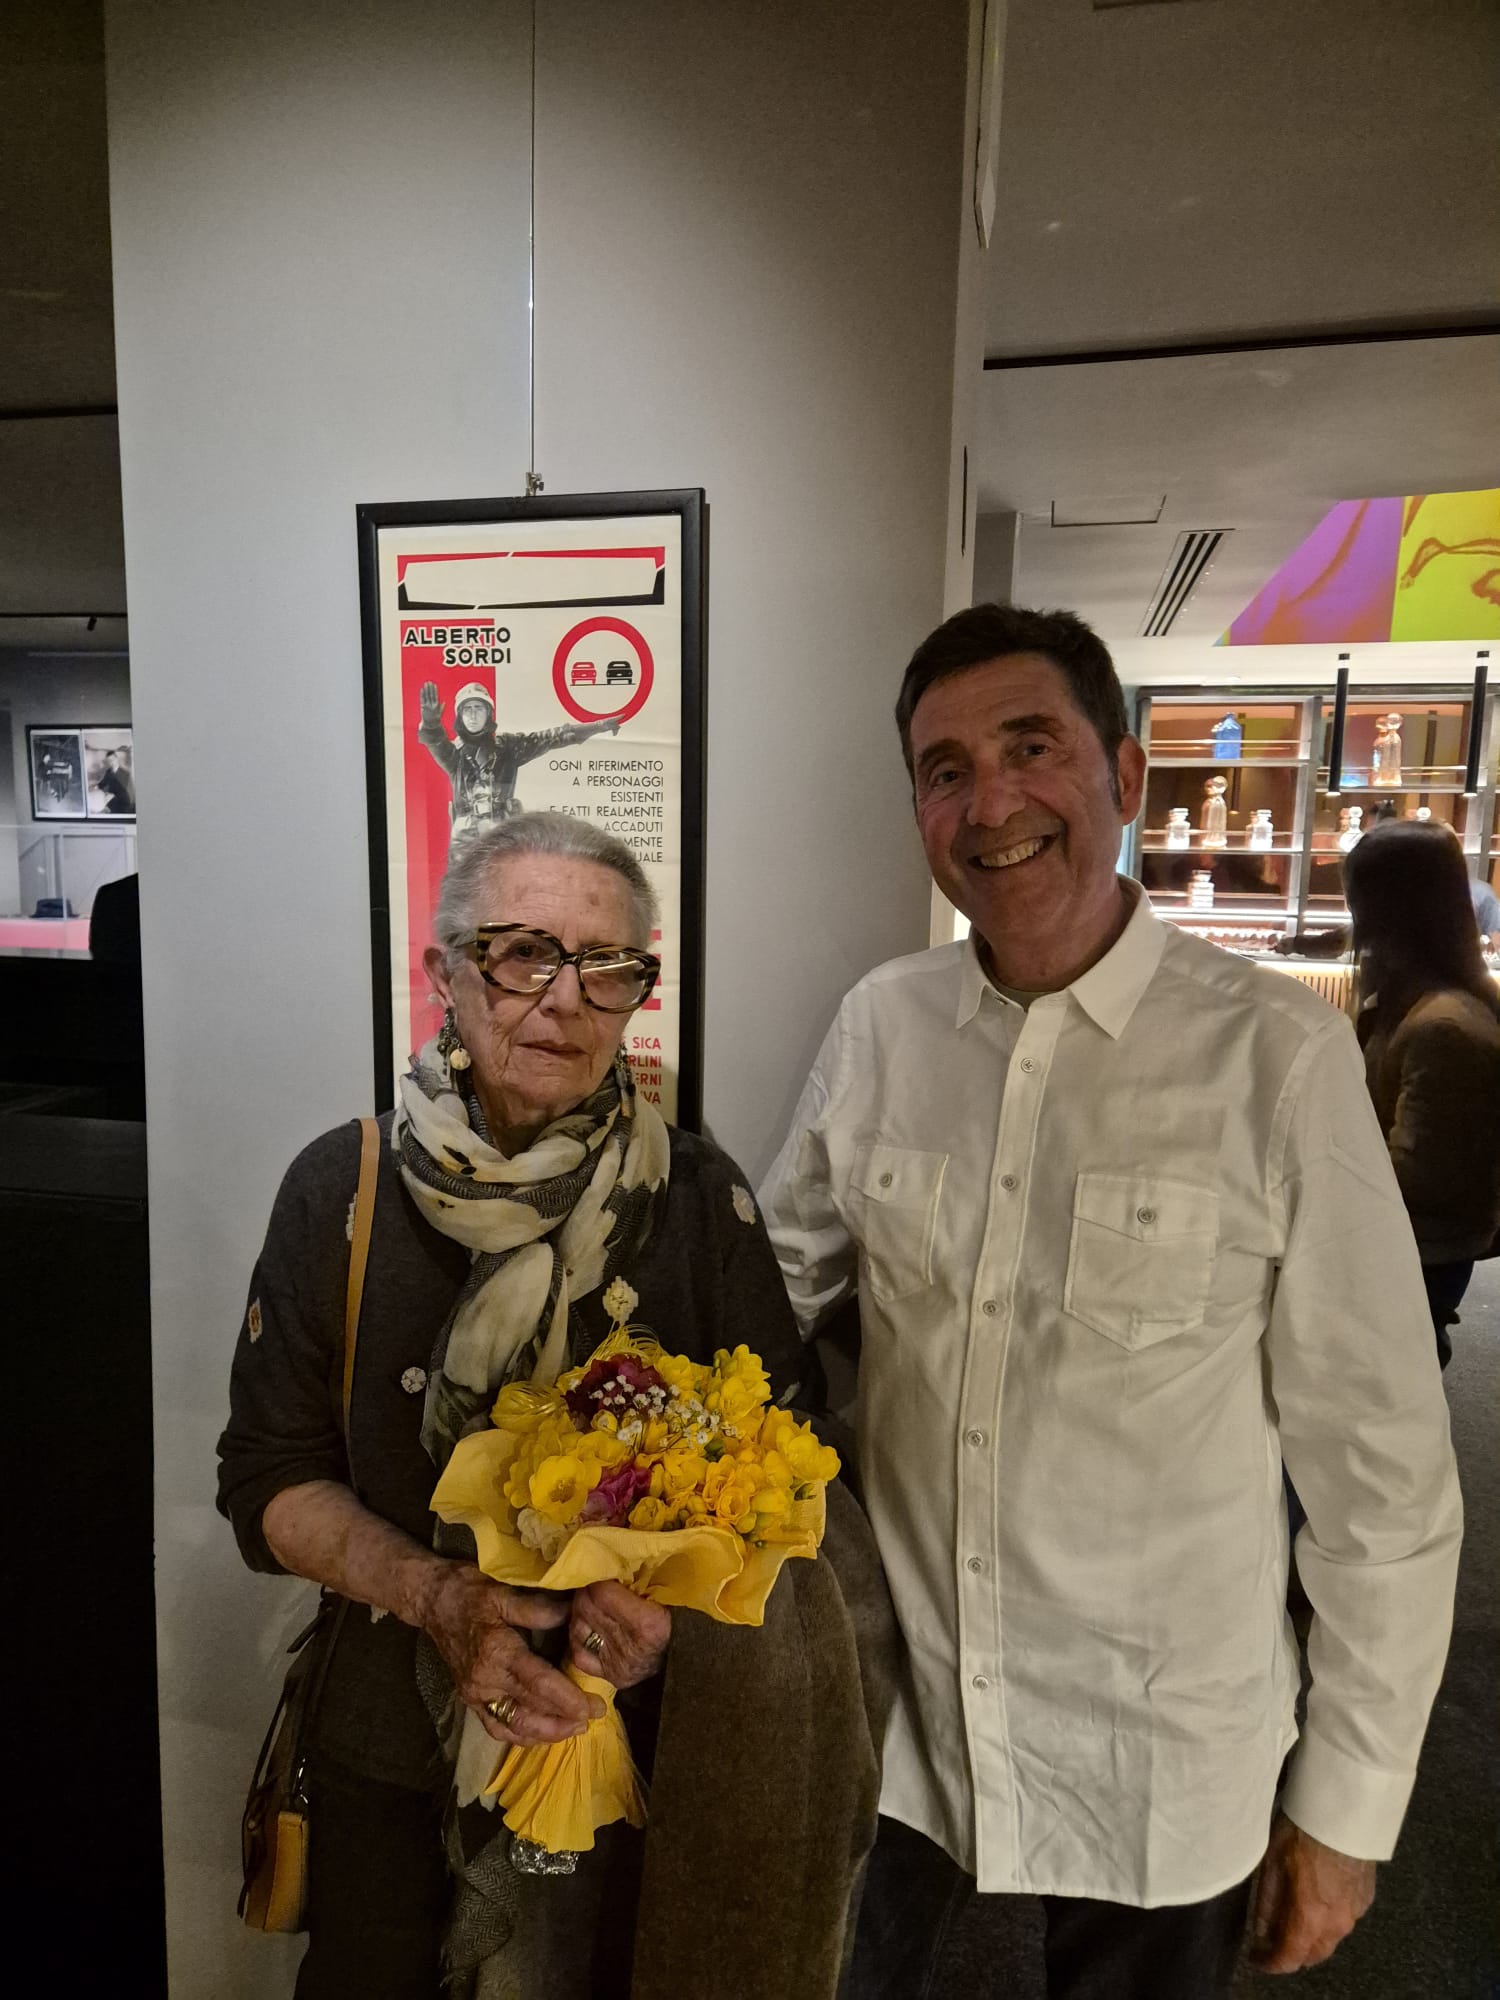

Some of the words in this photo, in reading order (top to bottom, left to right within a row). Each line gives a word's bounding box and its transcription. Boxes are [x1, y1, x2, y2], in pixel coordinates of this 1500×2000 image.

[405, 627, 511, 645] ALBERTO
[445, 647, 511, 665] SORDI
[549, 760, 582, 771] OGNI
[588, 760, 664, 771] RIFERIMENTO
[572, 777, 580, 786] A
[587, 776, 664, 787] PERSONAGGI
[610, 791, 664, 802] ESISTENTI
[562, 805, 590, 817] FATTI
[597, 806, 664, 818] REALMENTE
[604, 821, 663, 832] ACCADUTI
[623, 836, 663, 848] MENTE
[634, 851, 663, 863] UALE
[632, 1036, 662, 1050] SICA
[628, 1054, 662, 1068] RLINI
[635, 1072, 662, 1086] ERNI
[643, 1090, 662, 1105] VA
